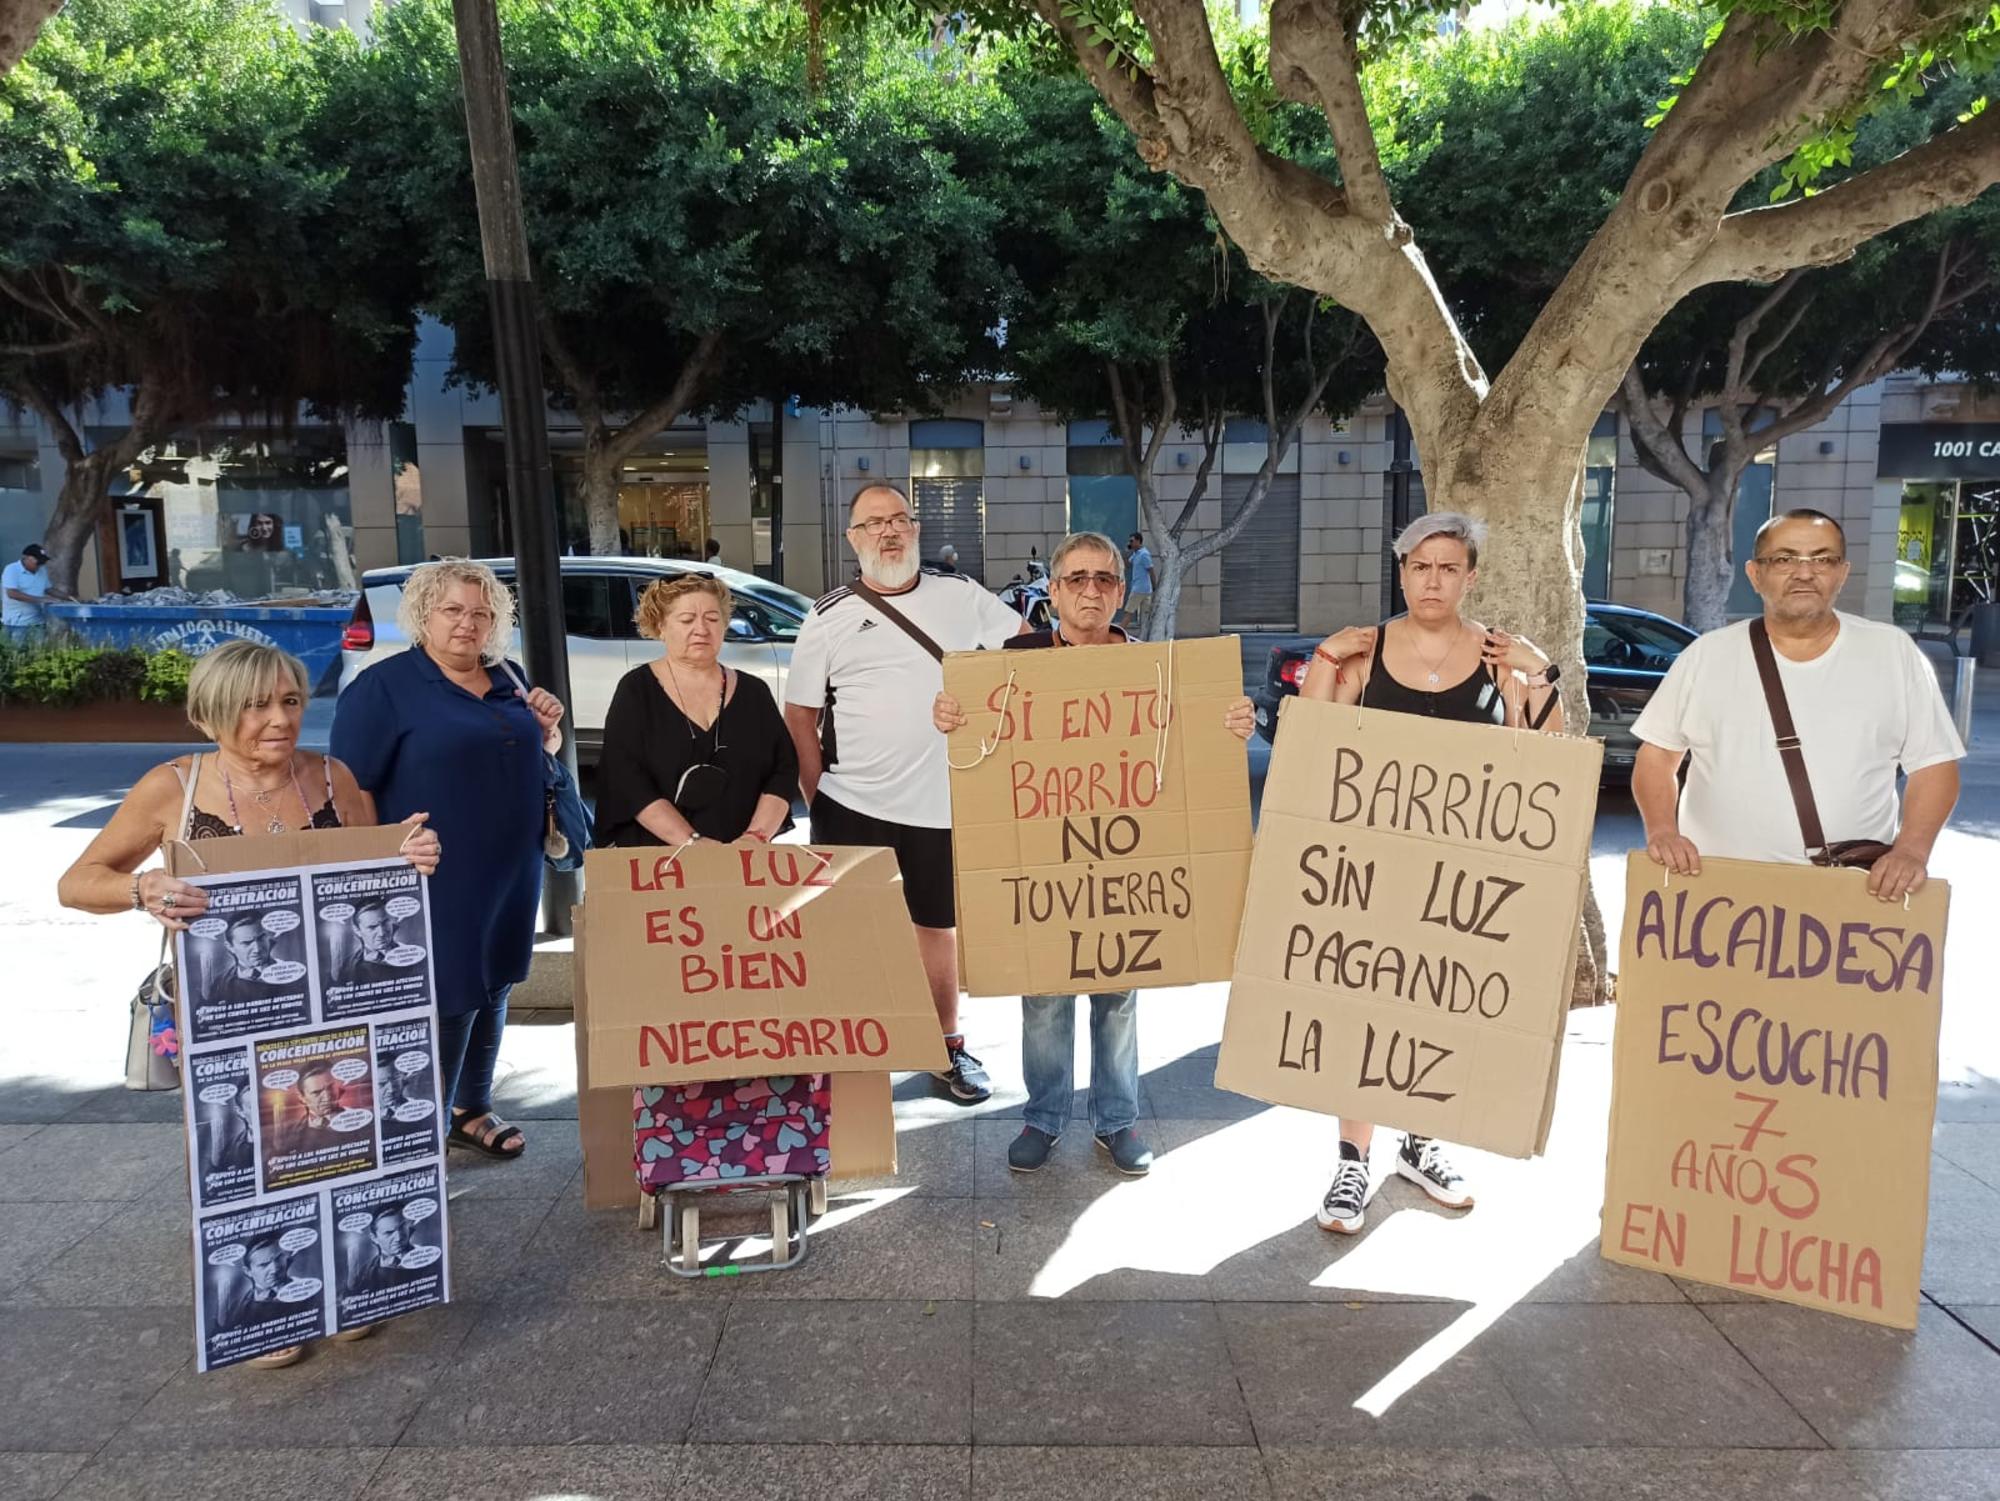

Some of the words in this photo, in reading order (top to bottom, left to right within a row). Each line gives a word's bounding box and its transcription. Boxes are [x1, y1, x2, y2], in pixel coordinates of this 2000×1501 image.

[1934, 441, 1973, 457] 1001
[1061, 691, 1111, 741] EN
[1011, 750, 1158, 819] BARRIO
[1329, 747, 1561, 851] BARRIOS
[1061, 815, 1141, 863] NO
[316, 874, 417, 896] CONCENTRACION
[629, 855, 685, 892] LA
[738, 849, 834, 887] LUZ
[1001, 864, 1191, 925] TUVIERAS
[645, 905, 705, 947] ES
[747, 905, 803, 942] UN
[1420, 861, 1526, 942] LUZ
[1069, 929, 1162, 980] LUZ
[1636, 889, 1934, 995] ALCALDESA
[680, 944, 807, 994] BIEN
[1283, 923, 1510, 1020] PAGANDO
[259, 1034, 366, 1063] CONCENTRACION
[638, 1018, 889, 1068] NECESARIO
[1277, 1011, 1323, 1073] LA
[1358, 1022, 1456, 1102] LUZ
[1658, 999, 1888, 1102] ESCUCHA
[1733, 1091, 1787, 1152] 7
[335, 1174, 435, 1208] CONCENTRACION
[1671, 1139, 1820, 1220] AÑOS
[206, 1203, 316, 1241] CONCENTRACION
[1620, 1202, 1687, 1267] EN
[1729, 1213, 1883, 1310] LUCHA
